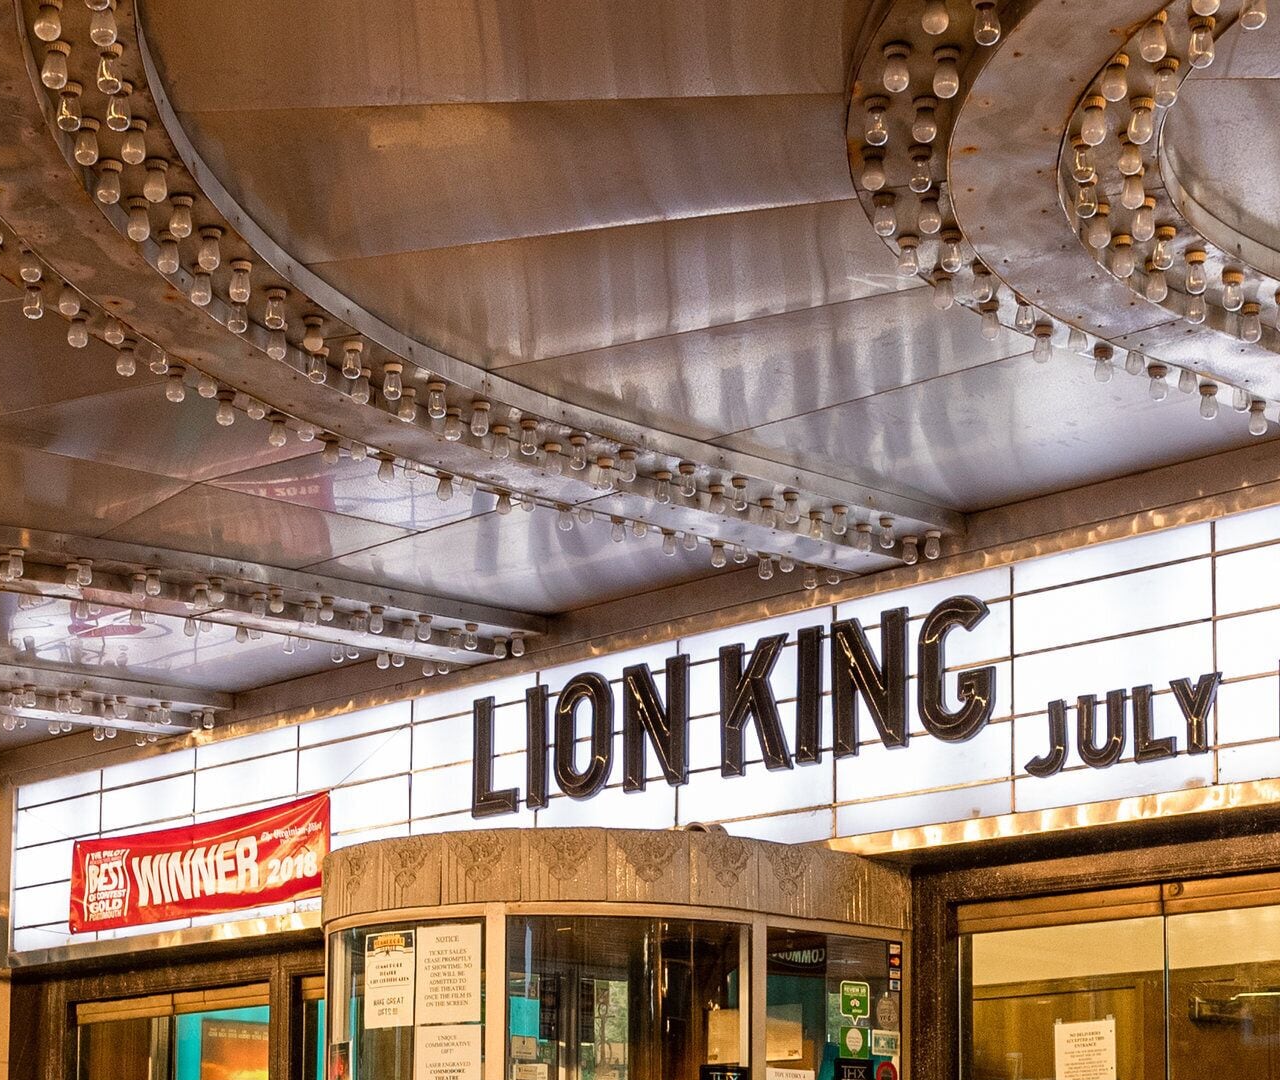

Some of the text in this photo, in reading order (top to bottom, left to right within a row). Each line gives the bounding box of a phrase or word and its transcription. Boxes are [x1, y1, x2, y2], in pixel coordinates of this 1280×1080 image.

[471, 594, 998, 820] LION KING
[1025, 671, 1224, 778] JULY
[103, 849, 126, 858] PILOT
[88, 860, 125, 894] BEST
[131, 836, 259, 907] WINNER
[266, 851, 318, 886] 2018
[89, 898, 123, 914] GOLD
[97, 889, 127, 900] CONTEST
[436, 935, 460, 943] NOTICE
[841, 1065, 867, 1080] THX
